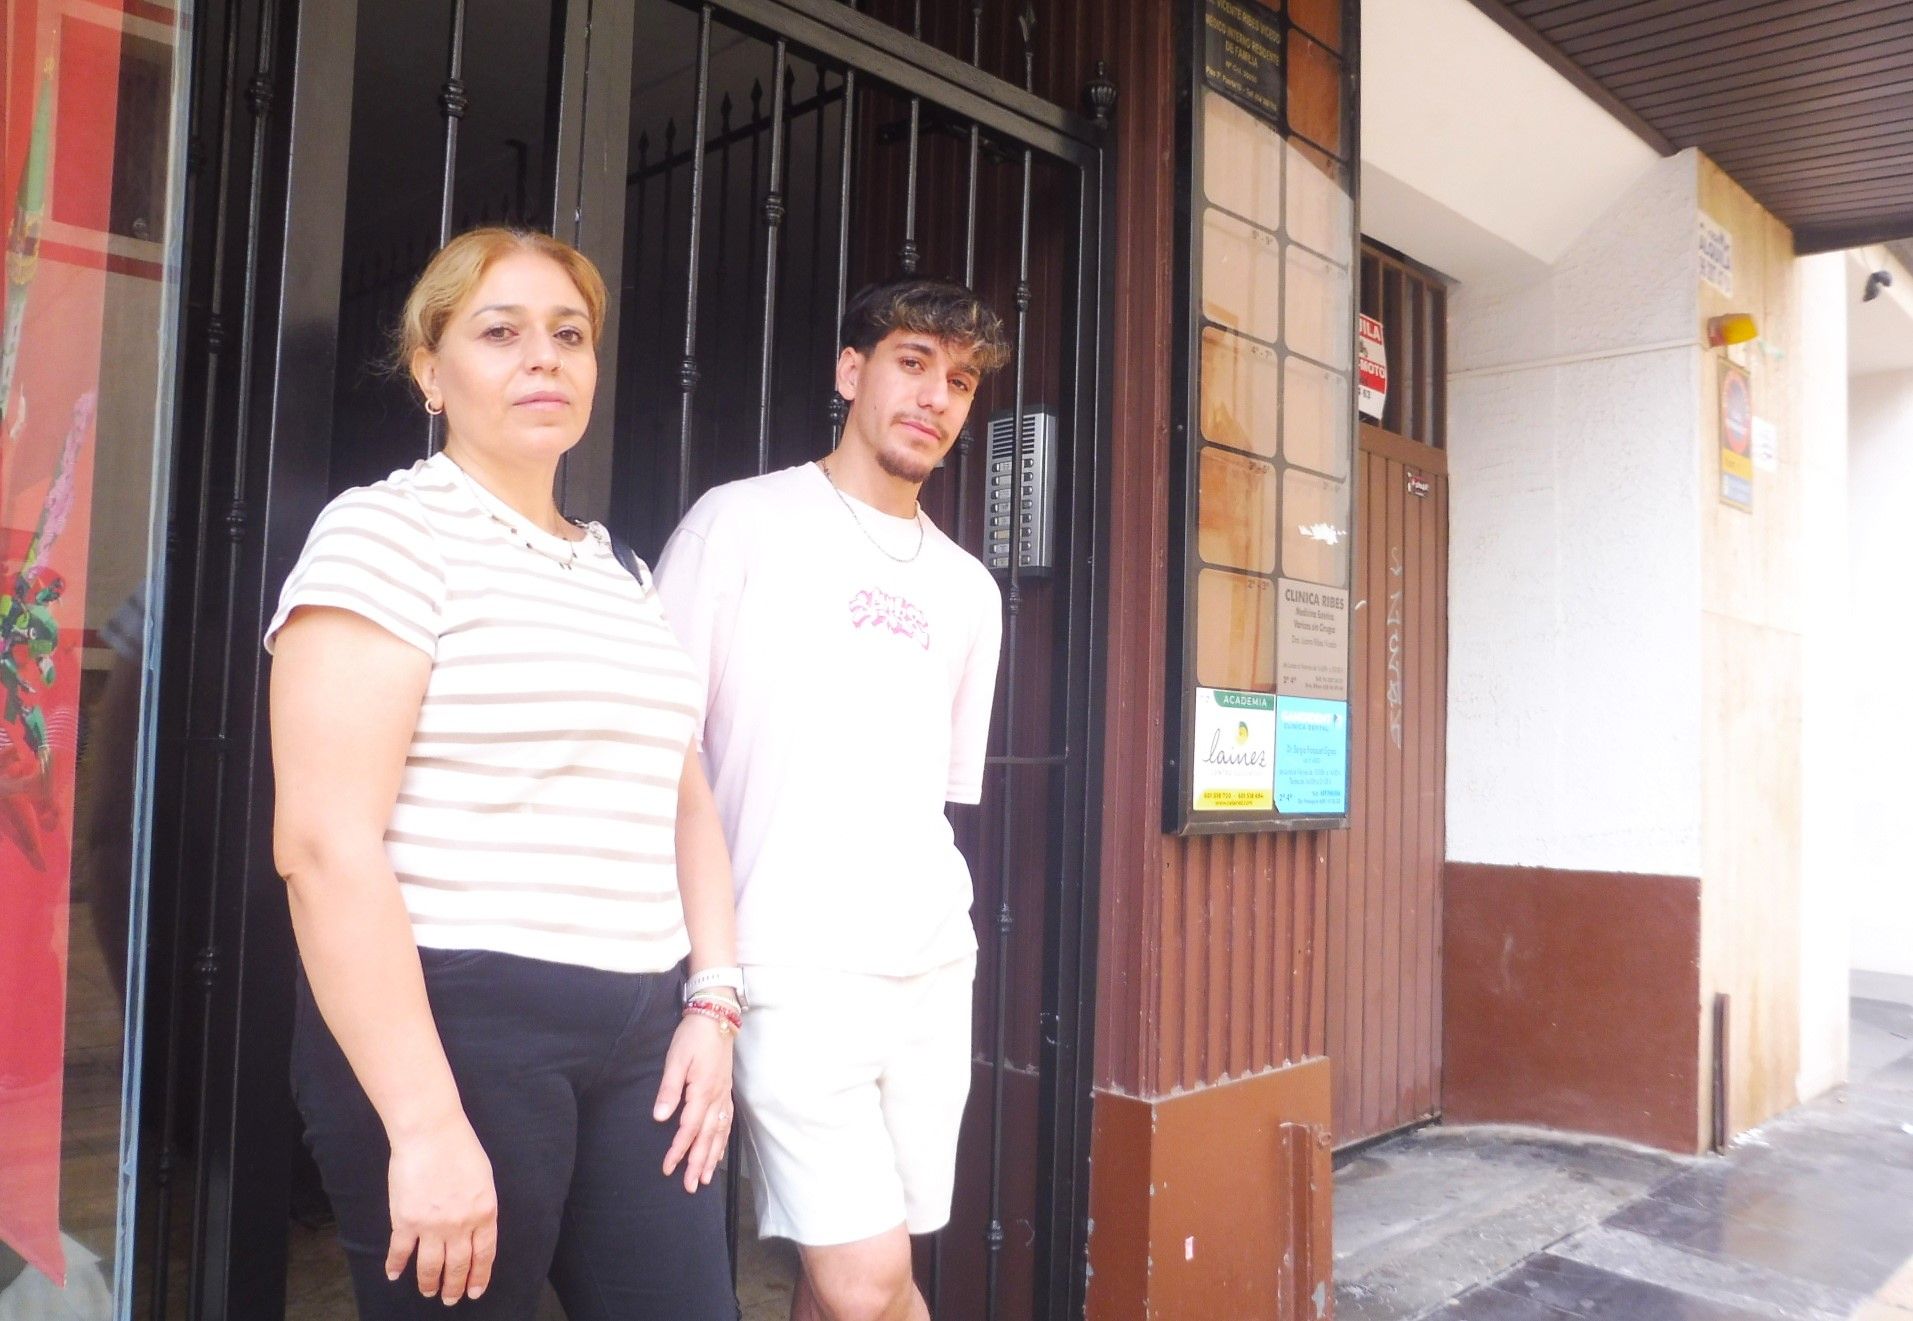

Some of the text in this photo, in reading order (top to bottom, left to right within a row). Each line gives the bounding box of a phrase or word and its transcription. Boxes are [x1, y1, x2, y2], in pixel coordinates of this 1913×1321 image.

[1285, 589, 1345, 610] CLINICA RIBES
[1223, 695, 1267, 707] ACADEMIA
